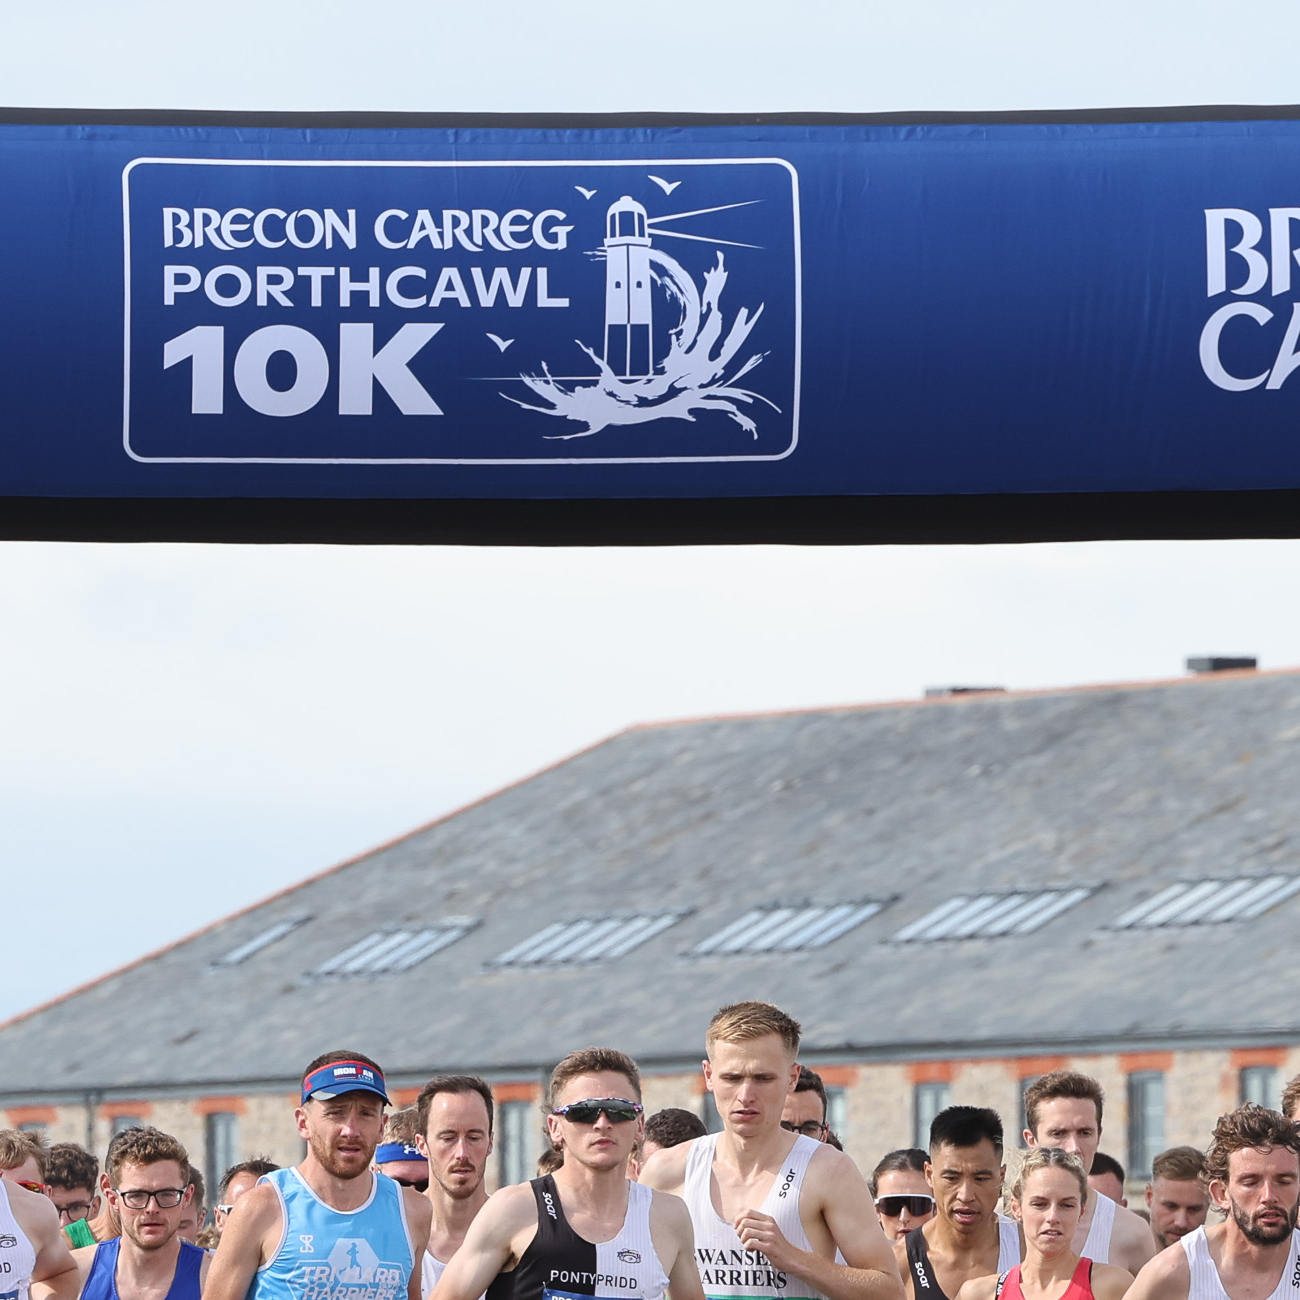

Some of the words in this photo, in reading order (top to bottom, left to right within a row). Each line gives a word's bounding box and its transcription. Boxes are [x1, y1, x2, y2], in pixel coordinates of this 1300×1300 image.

[162, 206, 358, 252] BRECON
[374, 207, 575, 252] CARREG
[163, 264, 570, 308] PORTHCAWL
[163, 322, 446, 417] 10K
[779, 1168, 796, 1199] soar
[542, 1191, 557, 1220] soar
[694, 1248, 773, 1266] WANSE
[301, 1266, 337, 1283] TRI
[550, 1270, 637, 1289] PONTYPRIDD
[698, 1268, 787, 1289] ARRIERS
[915, 1261, 930, 1289] soar
